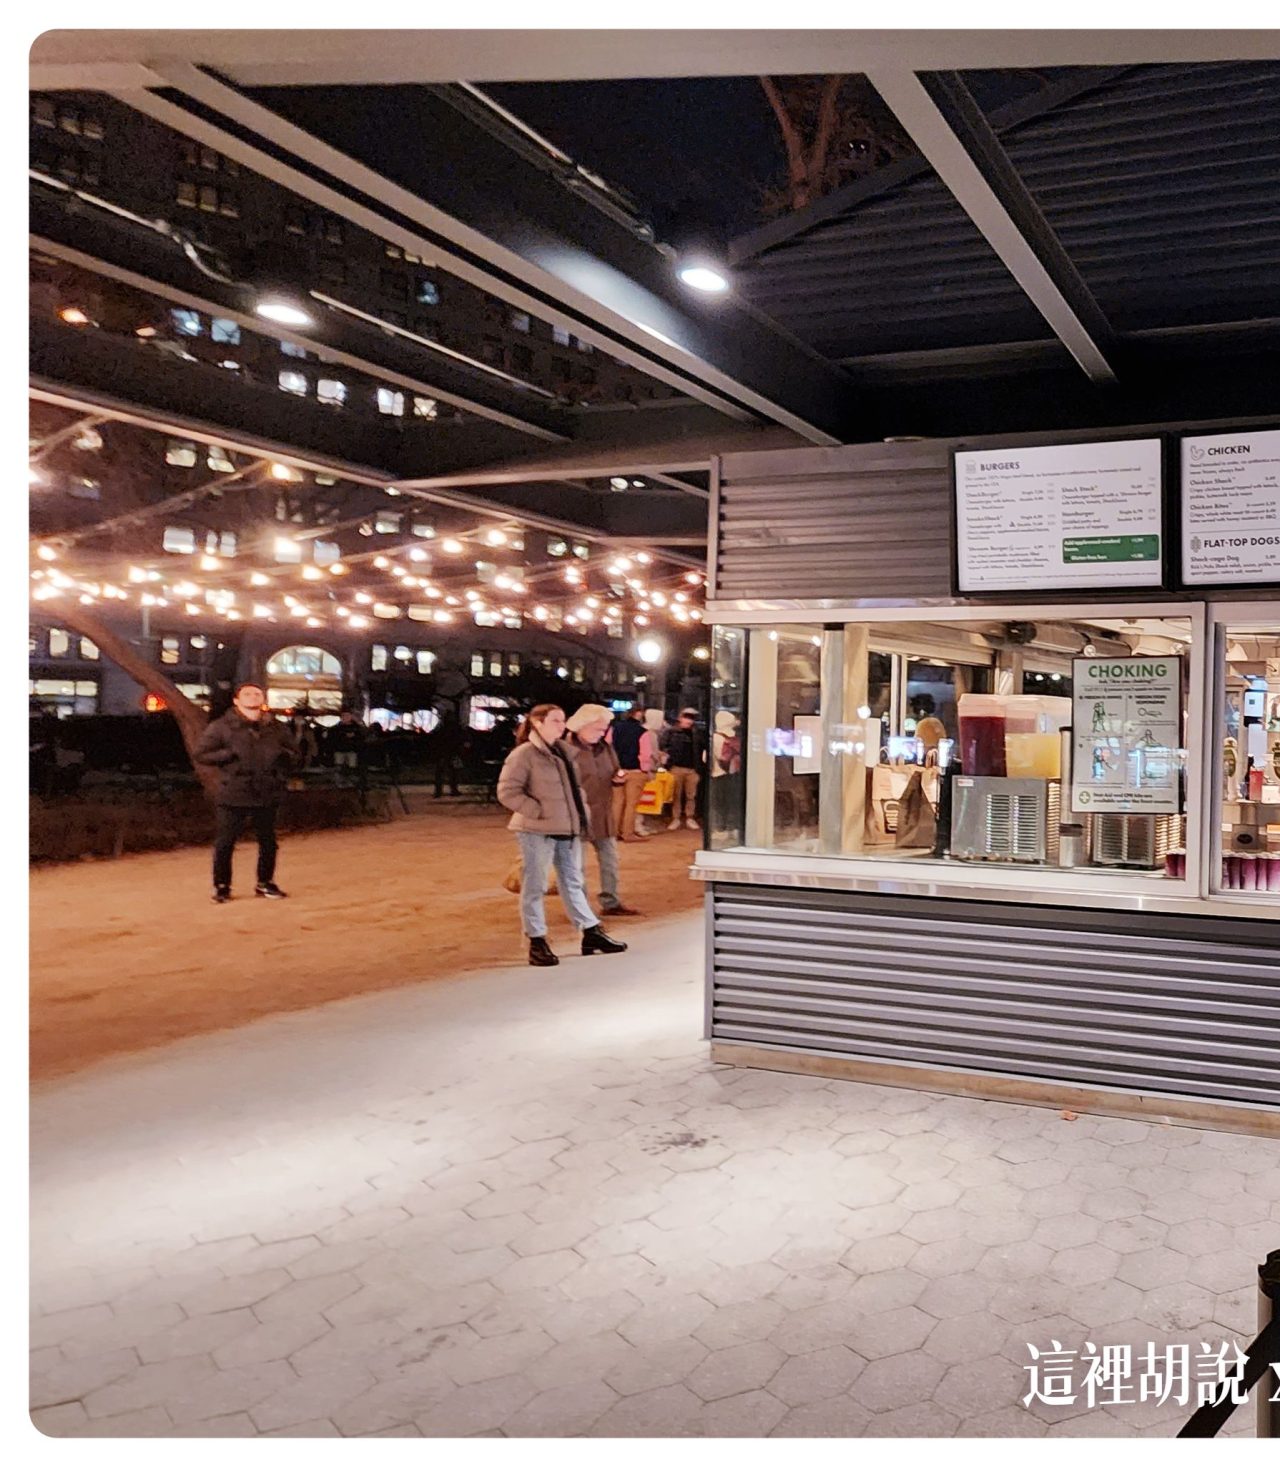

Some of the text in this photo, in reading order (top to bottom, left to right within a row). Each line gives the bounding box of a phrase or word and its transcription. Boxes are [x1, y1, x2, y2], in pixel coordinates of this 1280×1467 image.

[1207, 445, 1251, 456] CHICKEN
[980, 461, 1021, 471] BURGERS
[1203, 535, 1280, 549] FLAT-TOP DOGS
[1088, 663, 1169, 679] CHOKING
